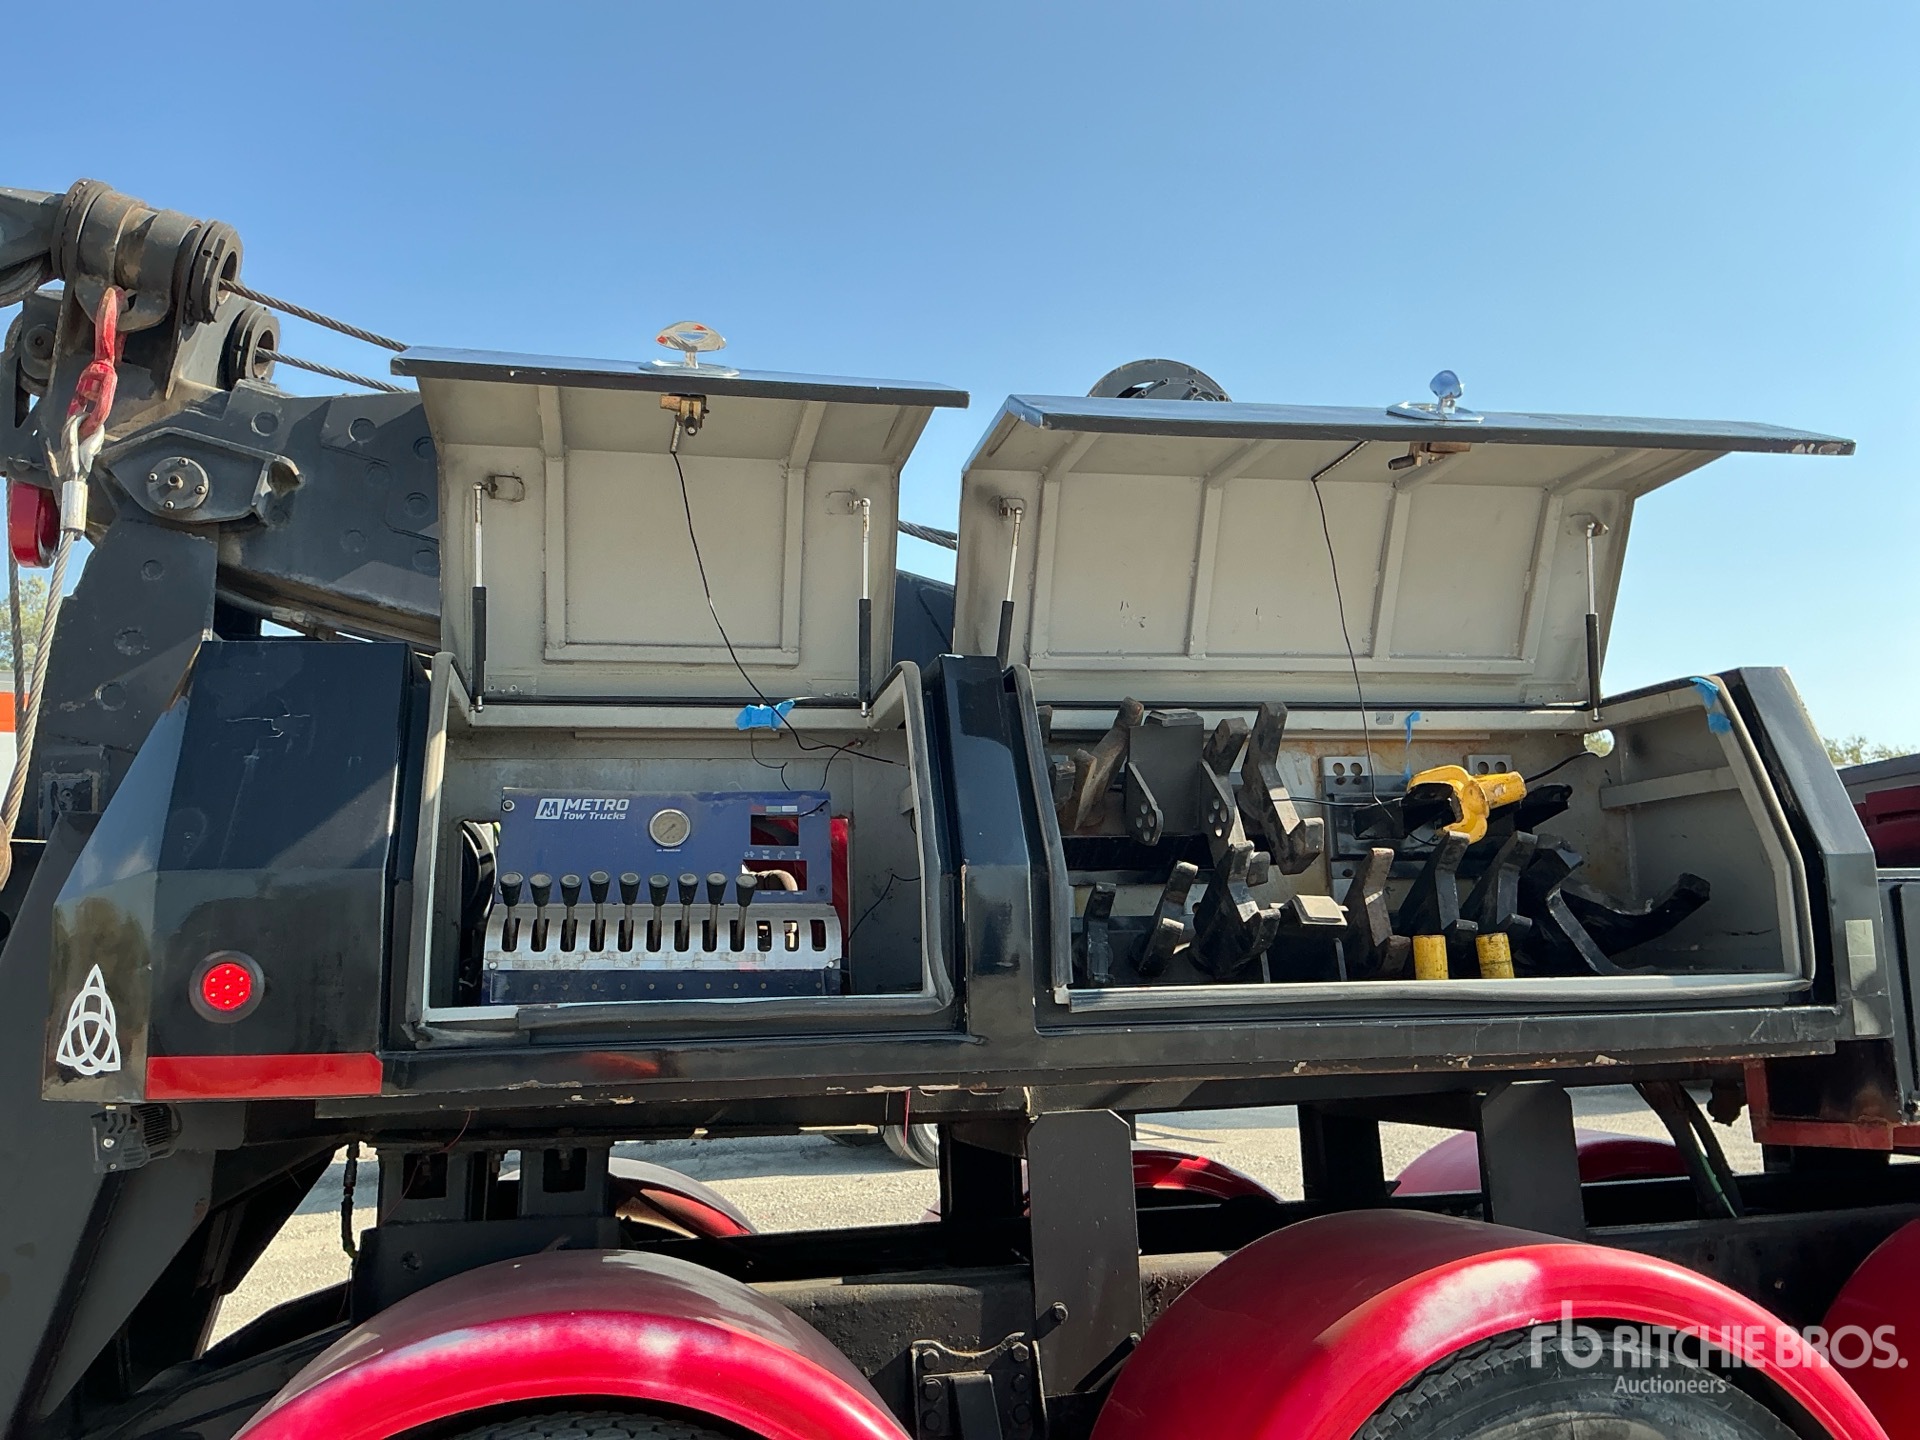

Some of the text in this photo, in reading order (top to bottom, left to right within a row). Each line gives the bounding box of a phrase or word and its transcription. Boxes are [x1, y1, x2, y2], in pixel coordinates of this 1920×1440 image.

[564, 798, 630, 811] METRO
[563, 811, 627, 820] Tow Trucks
